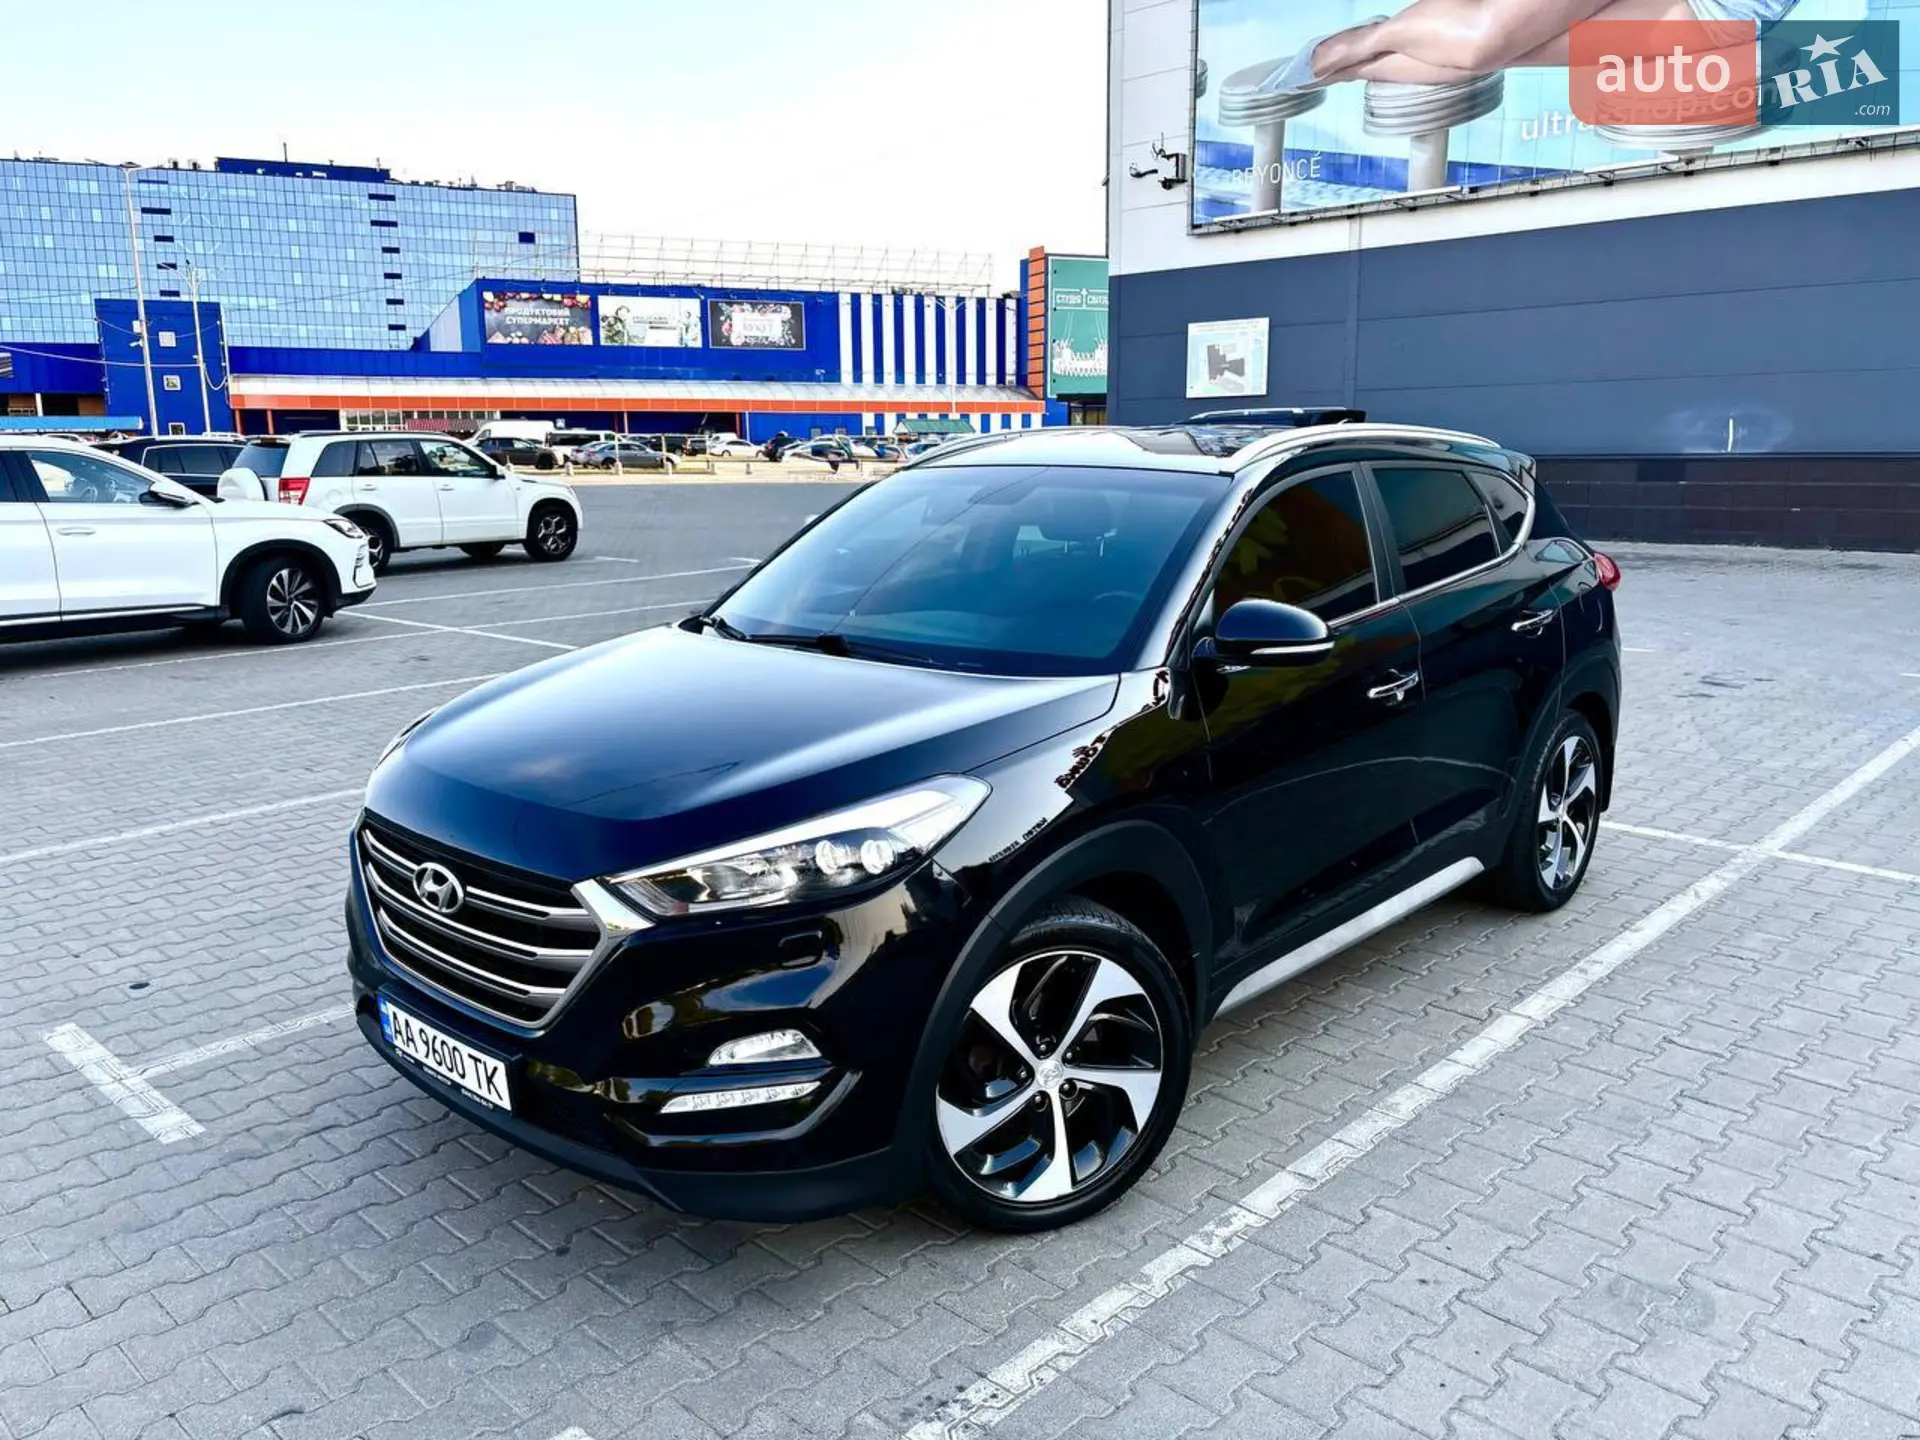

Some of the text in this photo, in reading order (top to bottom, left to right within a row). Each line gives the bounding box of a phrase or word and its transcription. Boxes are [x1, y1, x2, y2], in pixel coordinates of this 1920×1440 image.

[1232, 150, 1322, 184] BEYONCÉ
[392, 1011, 419, 1054] AA
[418, 1027, 466, 1080] 9600
[468, 1052, 503, 1102] TK
